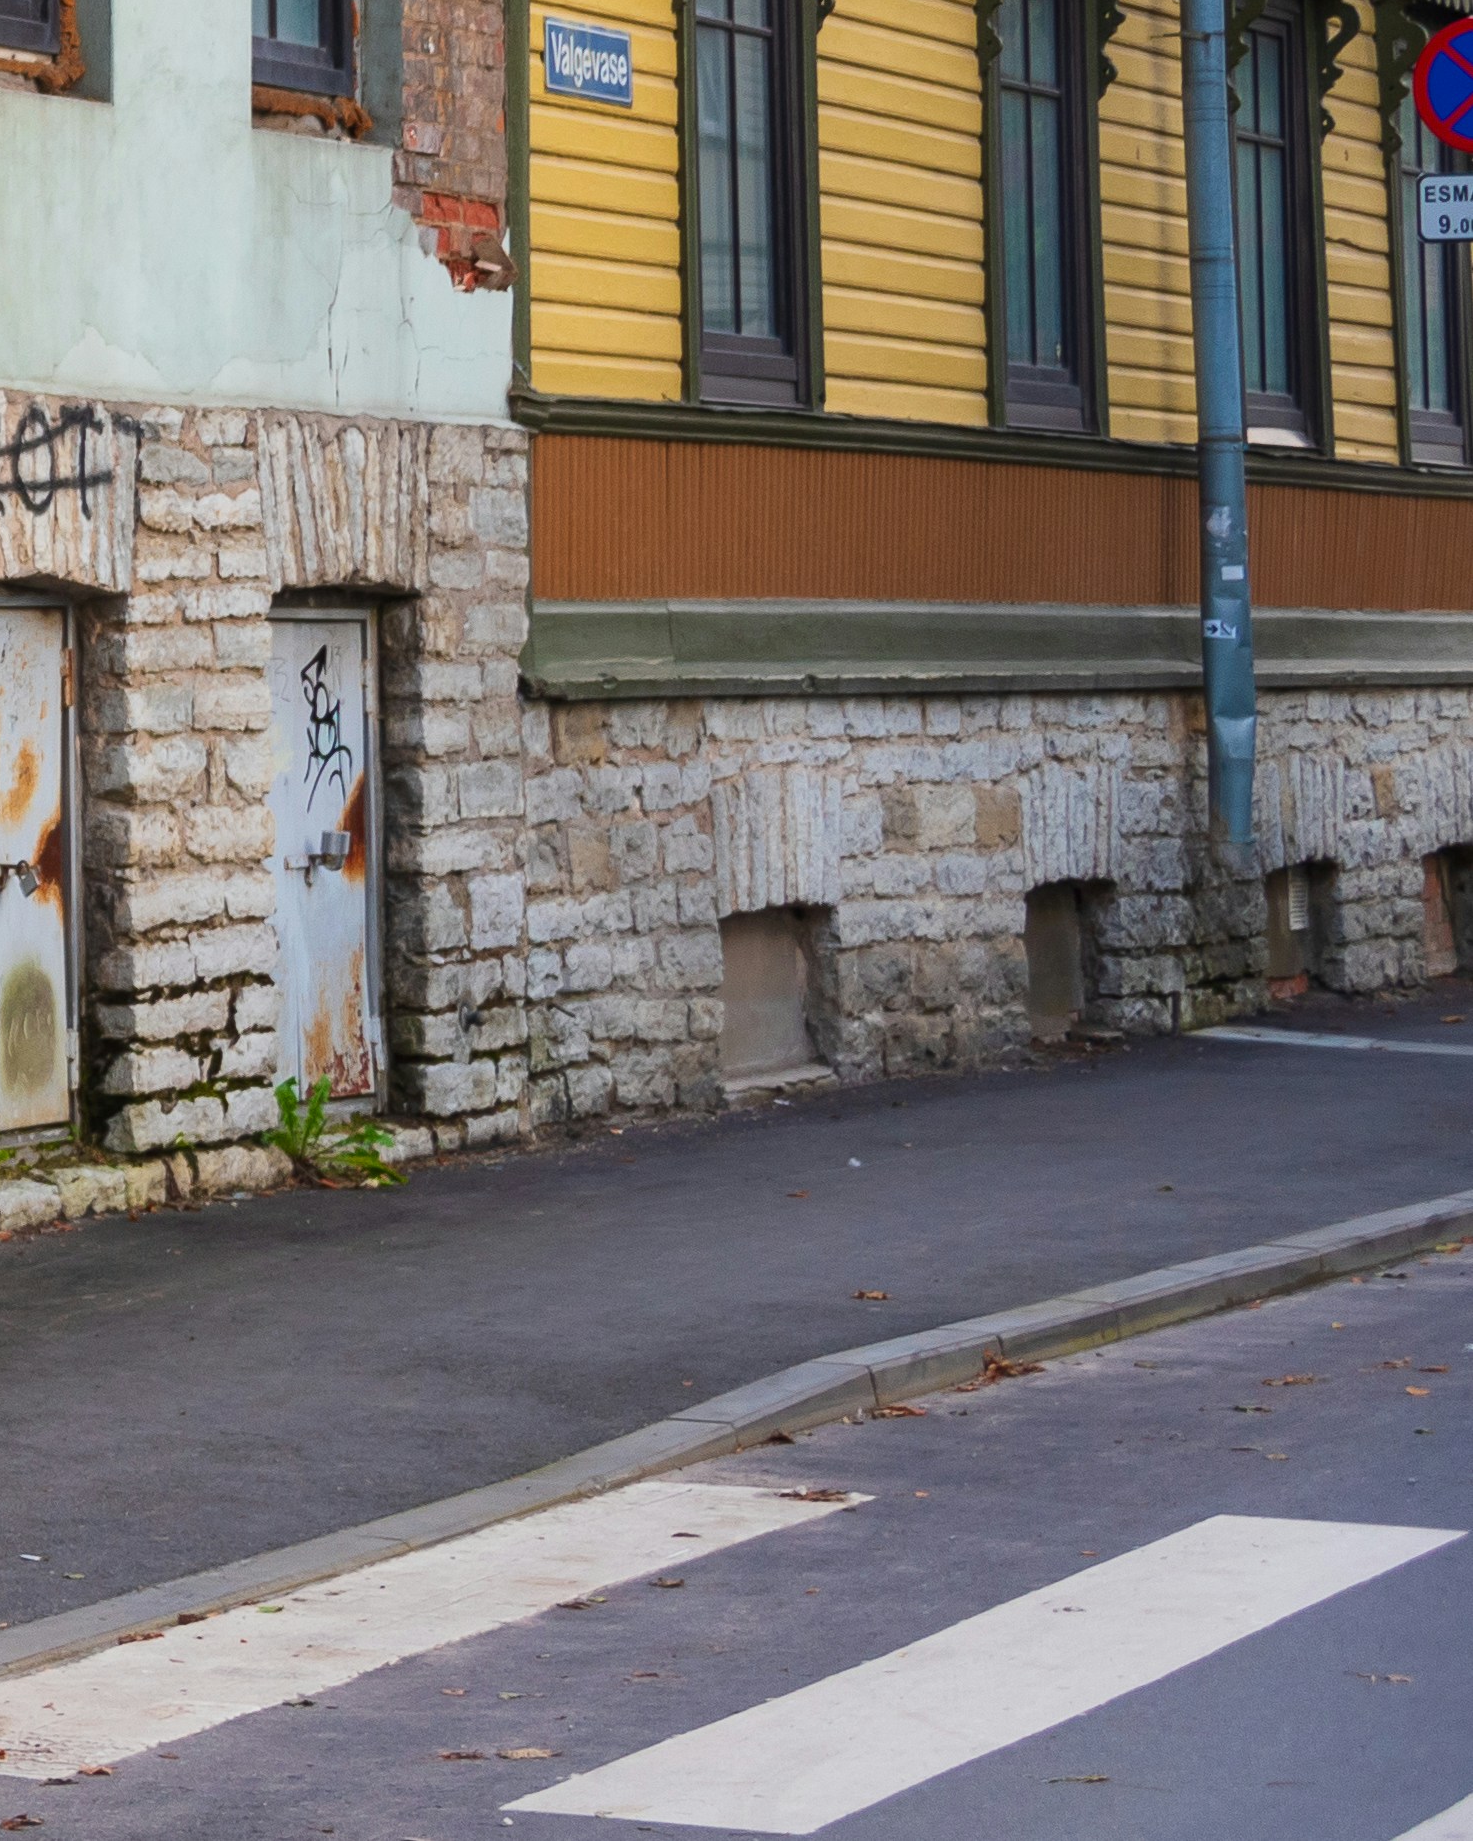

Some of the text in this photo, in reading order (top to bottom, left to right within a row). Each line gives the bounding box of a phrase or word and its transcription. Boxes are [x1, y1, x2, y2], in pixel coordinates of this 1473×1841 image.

[550, 31, 628, 88] Valgevase
[1424, 185, 1473, 203] ESM
[1438, 214, 1473, 234] 9.0
